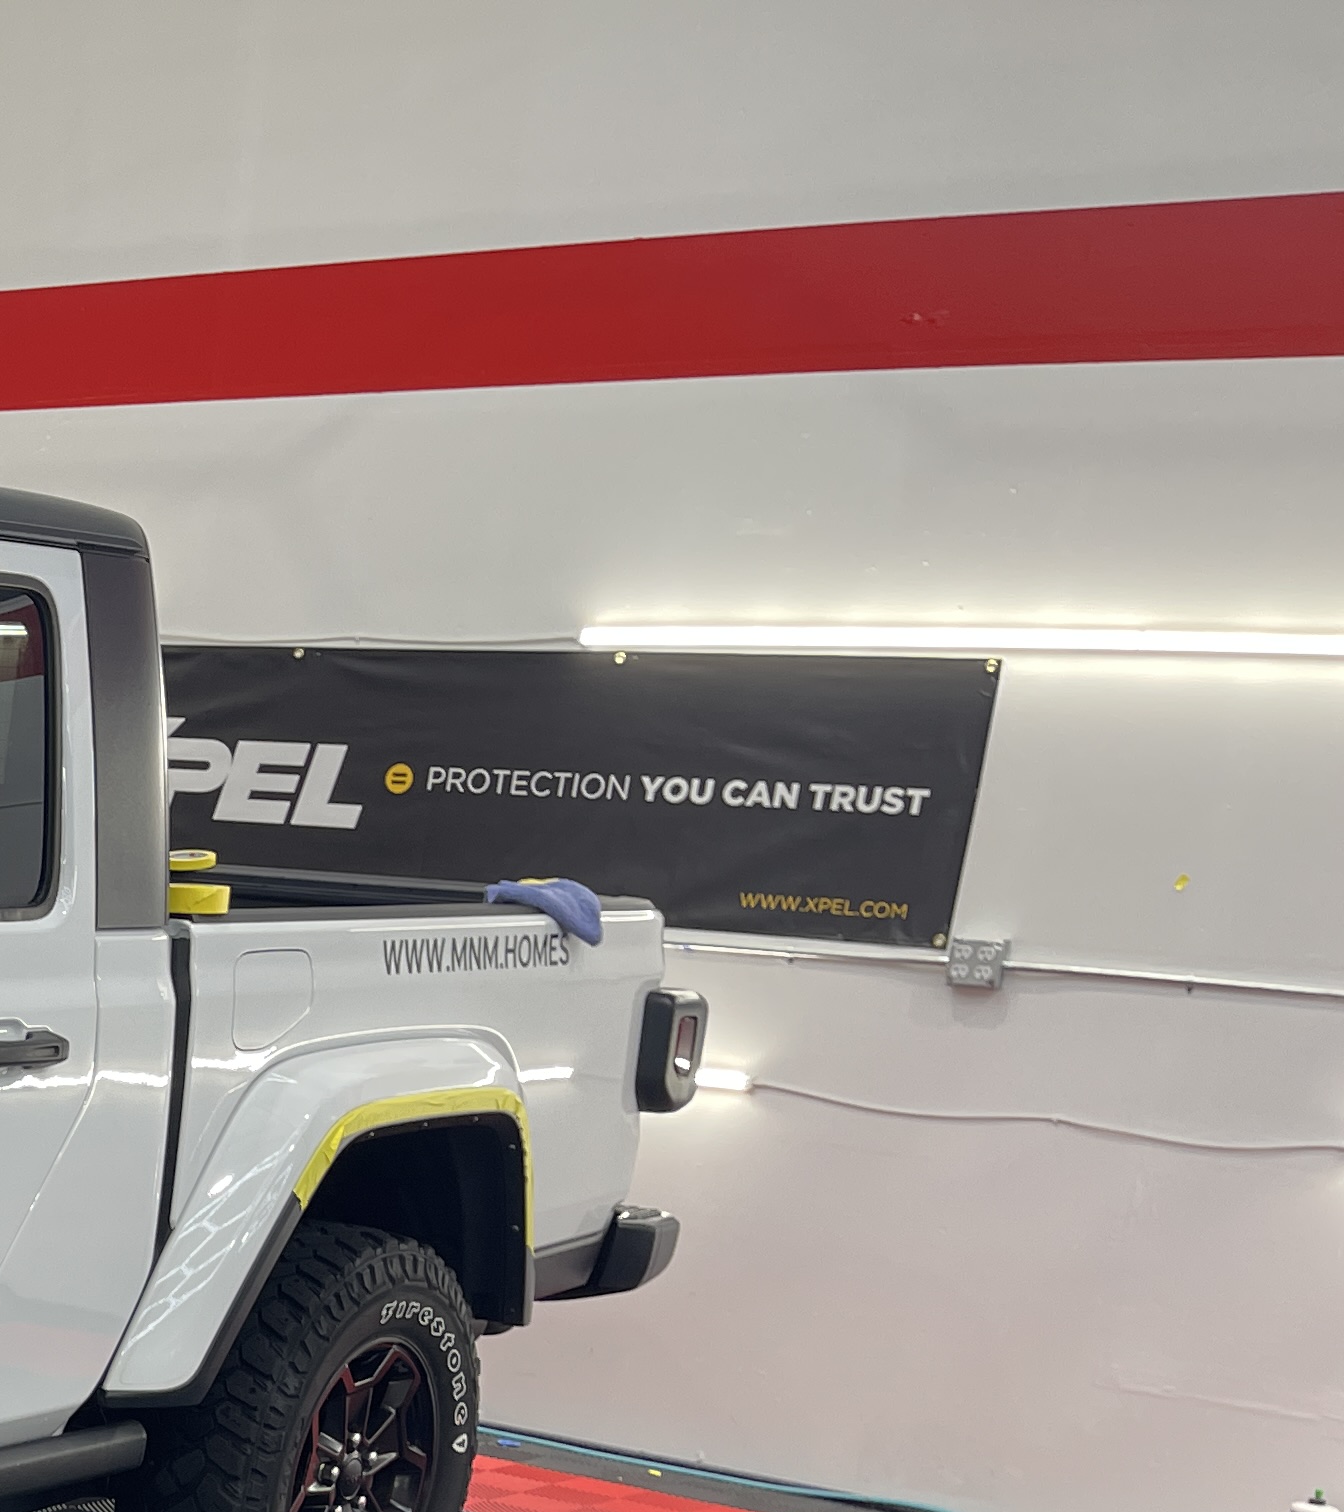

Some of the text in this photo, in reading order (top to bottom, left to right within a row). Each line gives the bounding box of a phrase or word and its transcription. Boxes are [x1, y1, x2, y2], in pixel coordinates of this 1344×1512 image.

[166, 717, 931, 829] PEL PROTECTION YOU CAN TRUST
[739, 892, 909, 920] WWW.XPEL.COM
[383, 933, 570, 975] WWW.MNM.HOMES
